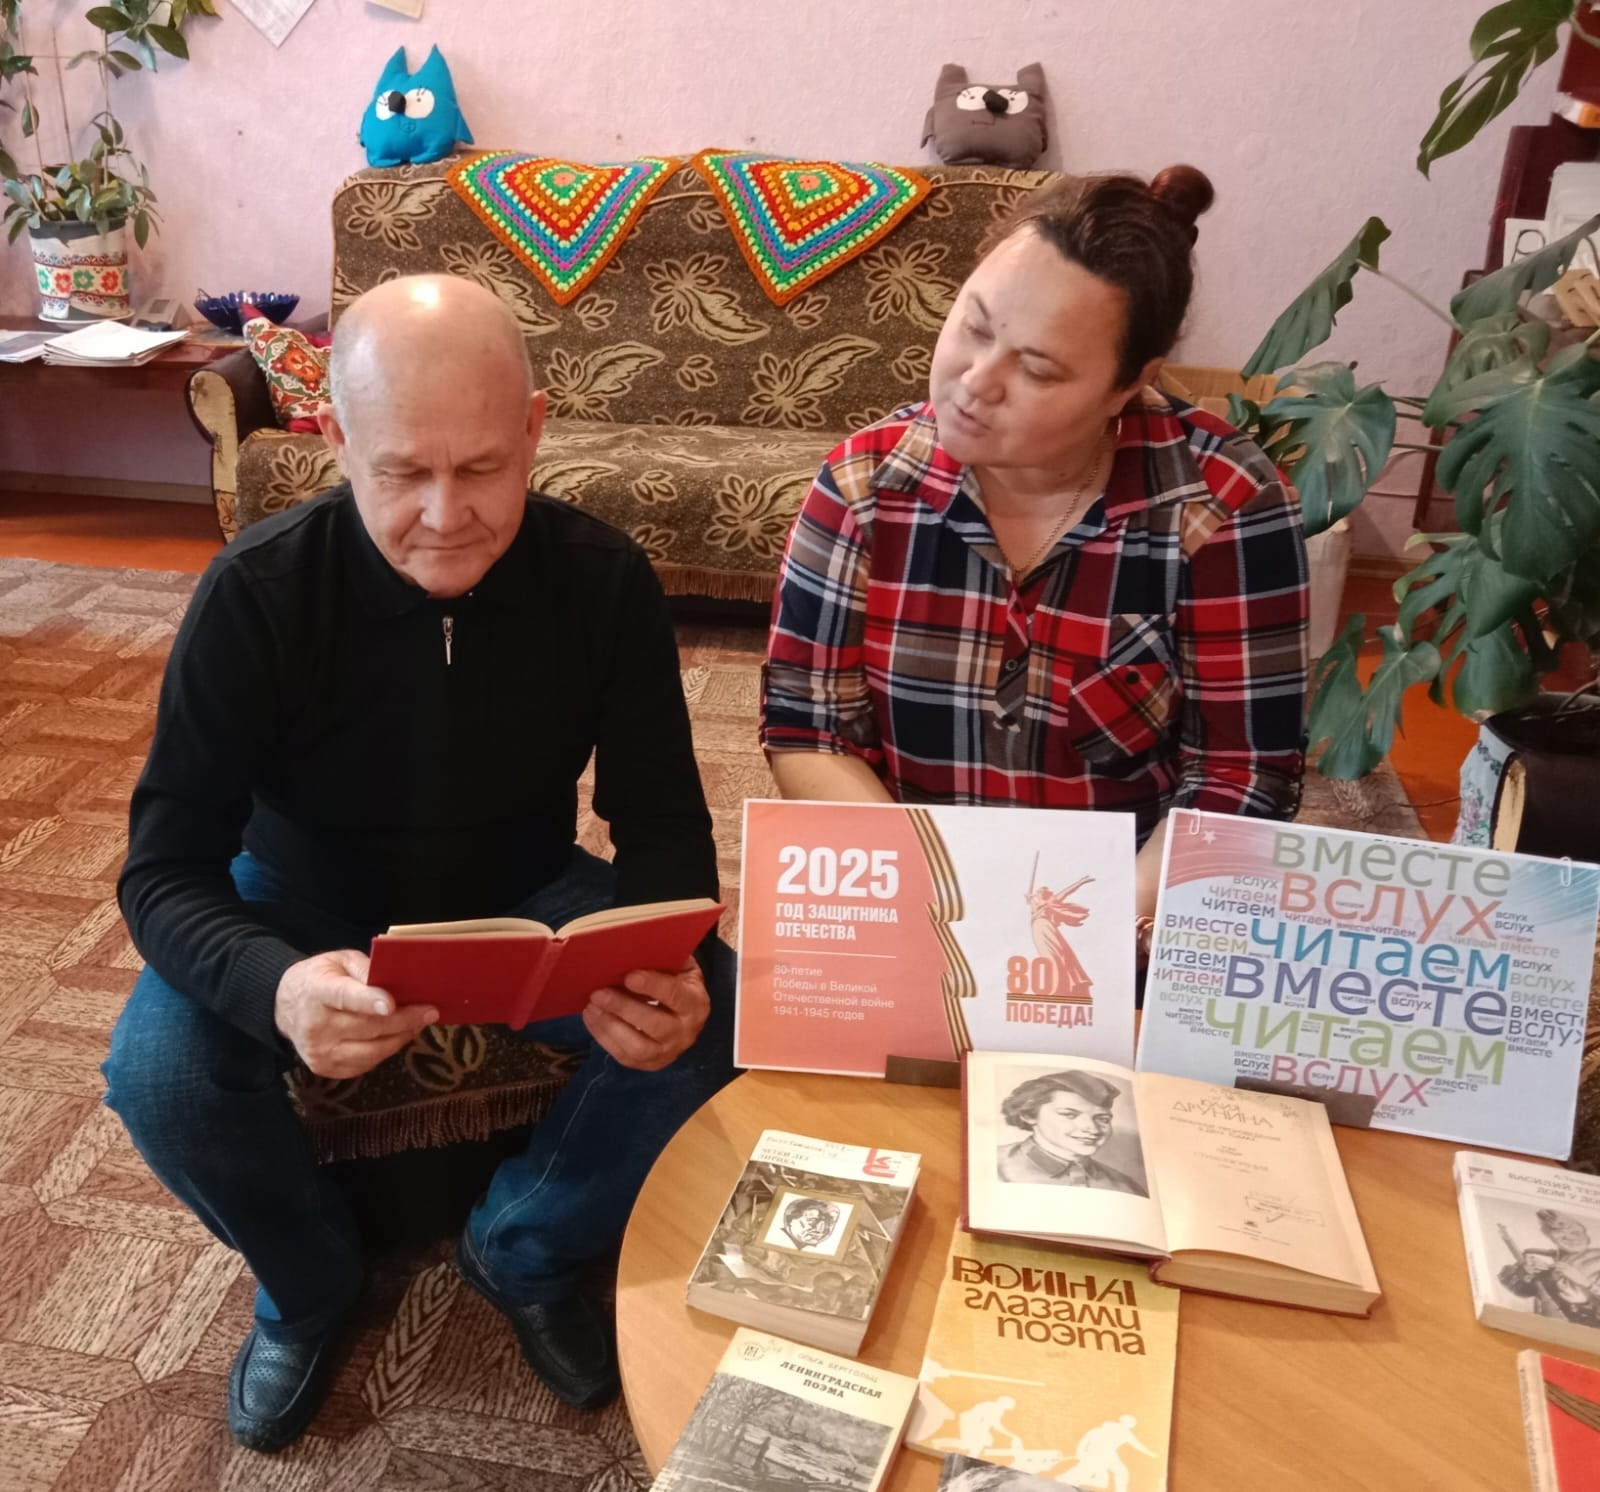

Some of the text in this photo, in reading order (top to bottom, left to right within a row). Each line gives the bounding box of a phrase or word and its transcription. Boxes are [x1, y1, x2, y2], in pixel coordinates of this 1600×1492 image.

[777, 845, 899, 899] 2025
[1272, 832, 1511, 897] вместе
[1233, 876, 1279, 890] вслух
[1209, 884, 1277, 904] читаем
[776, 902, 898, 923] ГОД ЗАЩИТНИКА
[1201, 897, 1275, 918] читаем
[1280, 872, 1502, 944] вслух
[1496, 911, 1528, 922] вслух
[1165, 914, 1248, 938] вместе
[1285, 912, 1332, 925] читаем
[1494, 920, 1535, 935] вслух
[775, 922, 857, 940] ОТЕЧЕСТВА
[1371, 926, 1417, 938] читаем
[1155, 947, 1227, 968] итаем
[1251, 918, 1510, 992] читаем
[1500, 941, 1560, 959] вместе
[1512, 959, 1552, 972] вслух
[773, 977, 817, 991] Победы
[830, 981, 877, 993] Великой
[1007, 956, 1054, 995] 80
[1510, 973, 1576, 993] вслух
[1171, 982, 1222, 997] вместе
[1224, 955, 1508, 1036] вместе
[773, 991, 895, 1009] Отечественной войне
[1391, 997, 1432, 1011] вслух
[1510, 991, 1584, 1012] вместе
[773, 1005, 865, 1021] 1941-1945 годов
[1006, 1002, 1093, 1029] ПОБЕДА!
[1190, 1026, 1230, 1038] вместе
[1205, 998, 1506, 1085] читаем
[1506, 1035, 1548, 1047] читаем
[1417, 1053, 1454, 1065] вместе
[1508, 1044, 1552, 1058] вместе
[1234, 1058, 1270, 1070] вслух
[1270, 1055, 1433, 1107] вслух
[1434, 1078, 1478, 1092] вместе
[1373, 1110, 1397, 1120] есте
[1381, 1104, 1415, 1116] вслух
[952, 1255, 1138, 1307] ВОЙНА
[964, 1287, 1141, 1331] глазами
[997, 1316, 1146, 1355] поэта
[780, 1361, 883, 1399] ЛЕНИНГРАДСКАЯ
[803, 1379, 845, 1399] ПОЭМА
